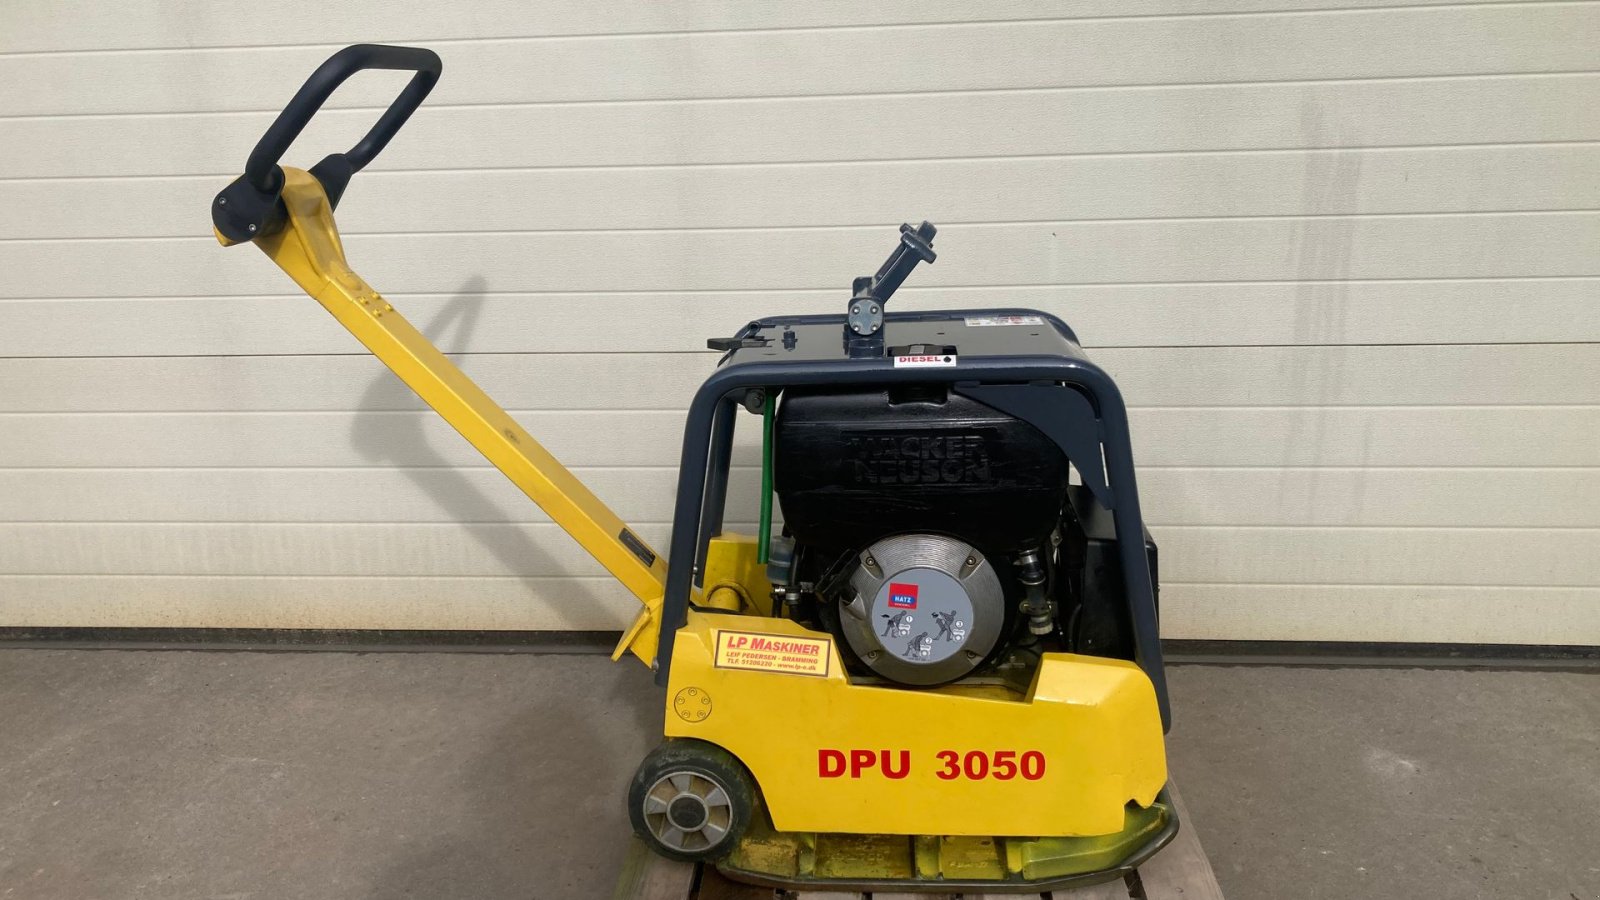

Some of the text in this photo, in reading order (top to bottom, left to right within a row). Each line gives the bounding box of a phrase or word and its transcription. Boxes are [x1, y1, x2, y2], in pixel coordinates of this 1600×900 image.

[854, 459, 989, 482] NEUSON
[894, 595, 912, 603] HATZ
[728, 636, 748, 648] LP
[742, 653, 777, 661] PEDERSEN
[782, 656, 818, 664] BRAMMING
[818, 749, 1046, 781] DPU 3050
